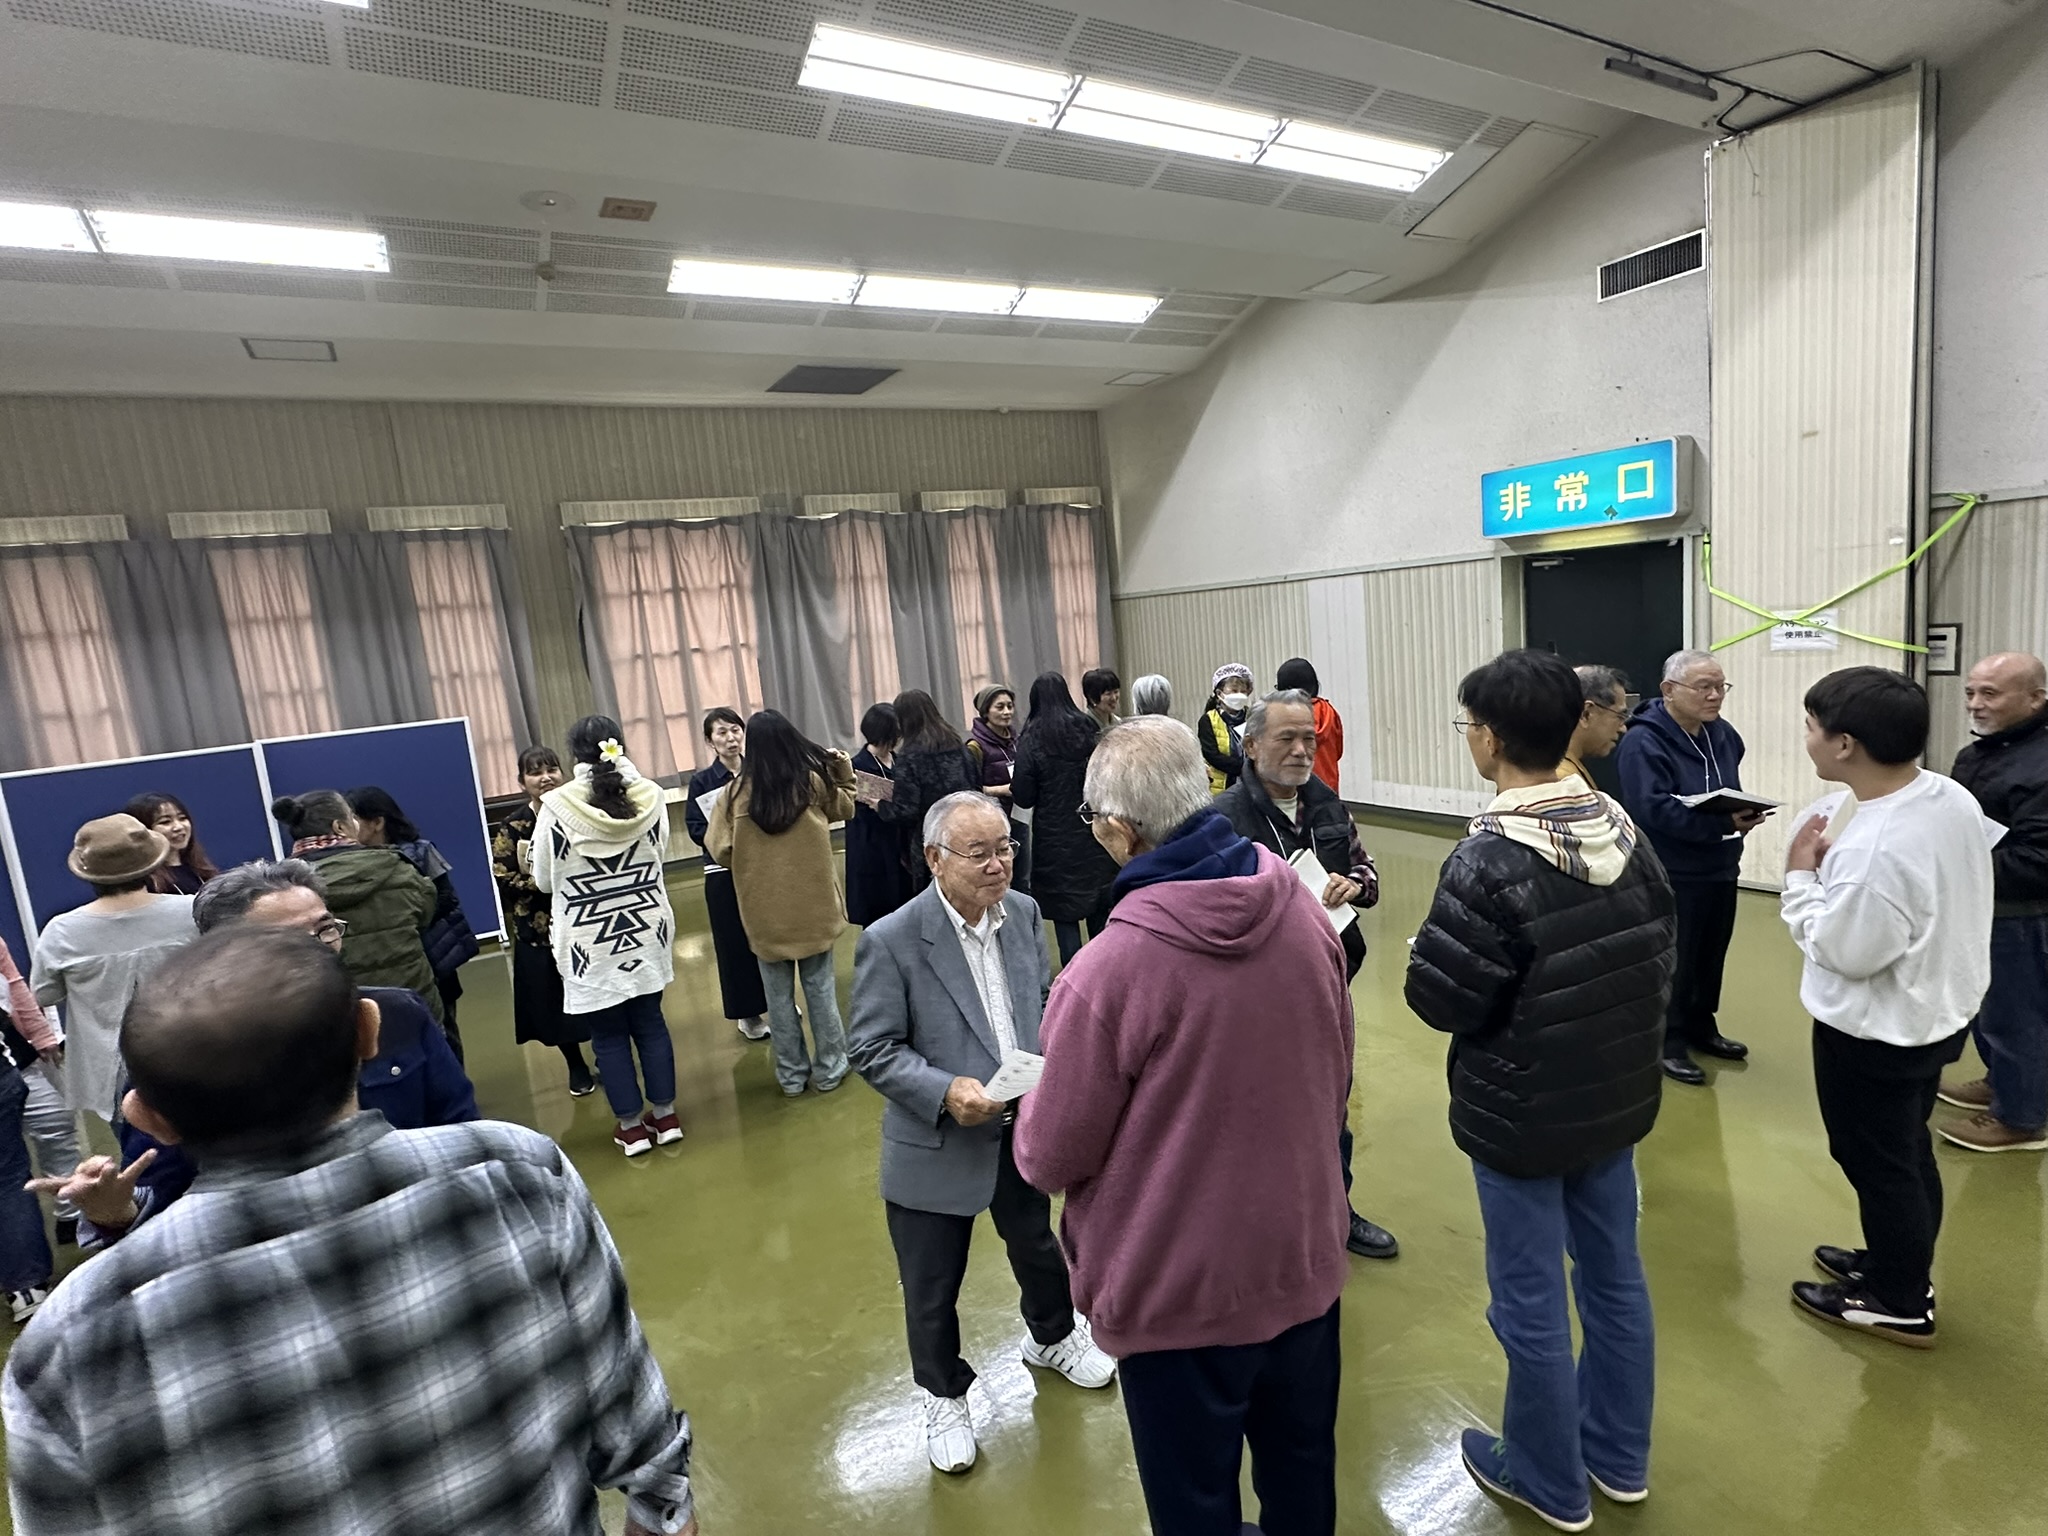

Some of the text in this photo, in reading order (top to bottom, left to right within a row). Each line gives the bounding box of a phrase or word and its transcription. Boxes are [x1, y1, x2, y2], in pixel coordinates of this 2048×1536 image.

[1499, 459, 1654, 522] 非常口
[1784, 630, 1822, 639] 使用禁止
